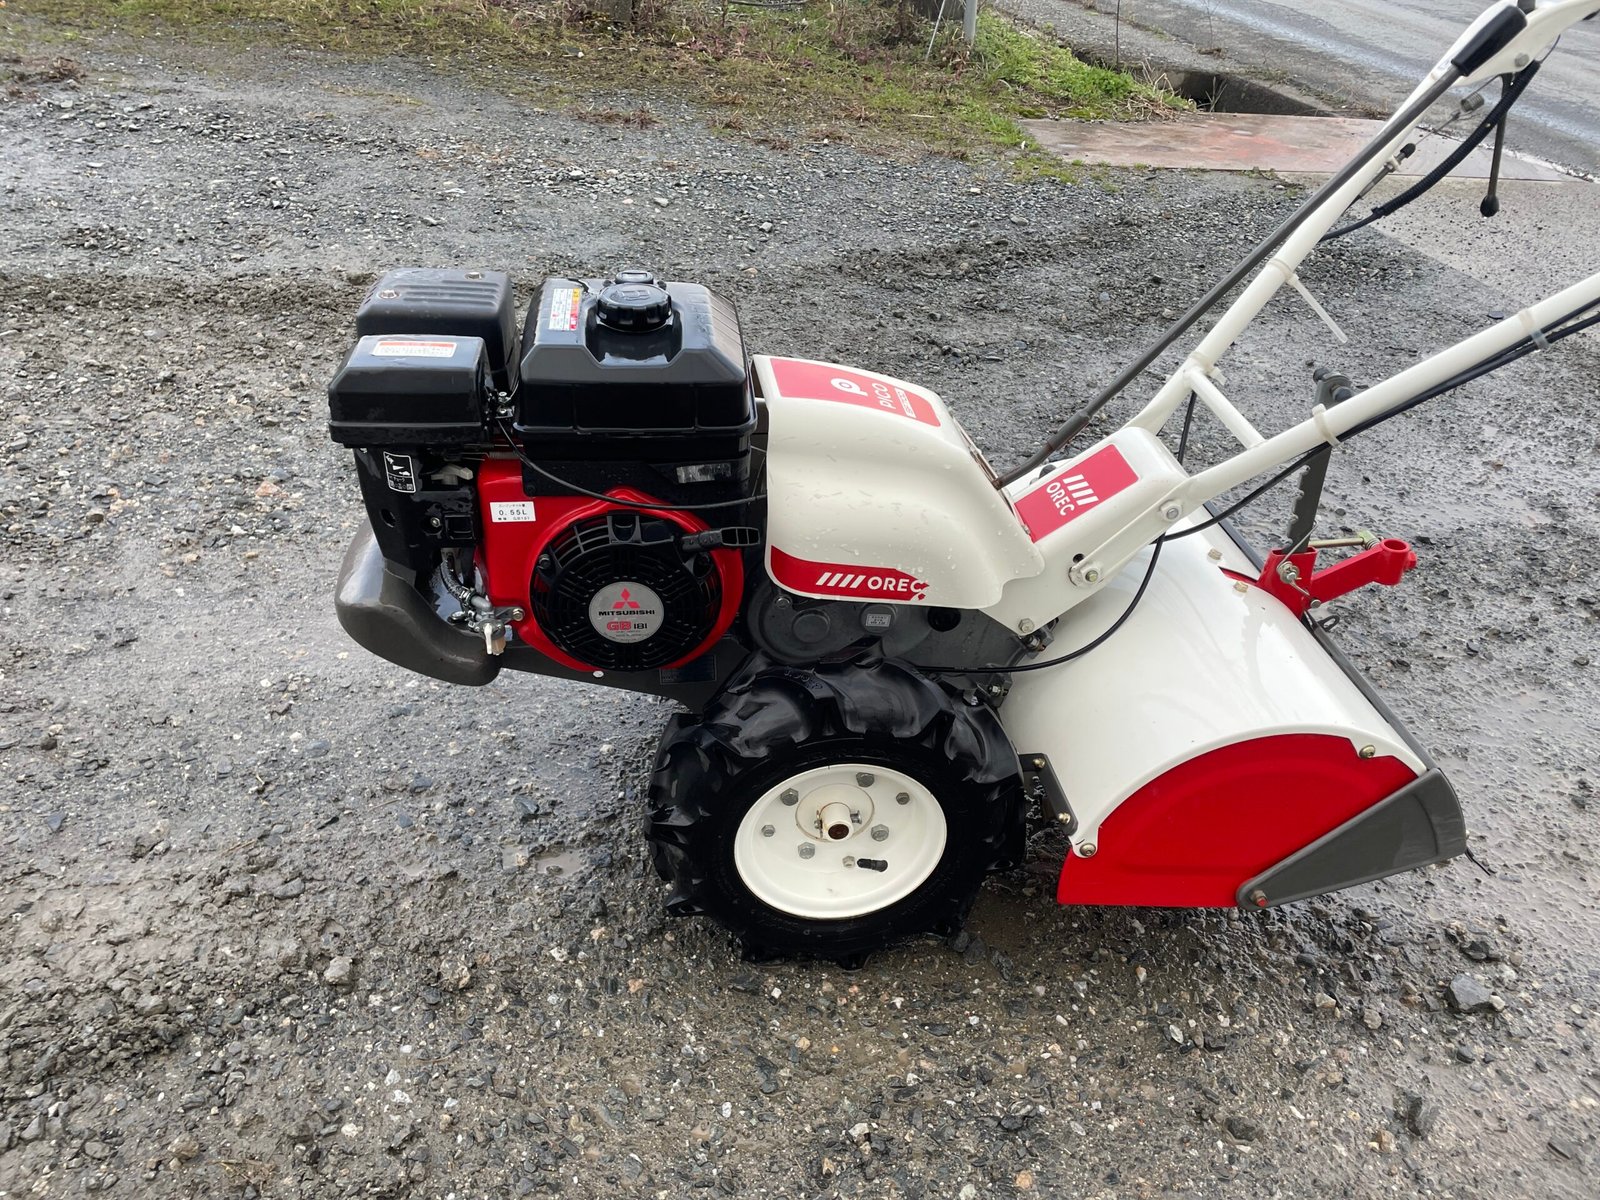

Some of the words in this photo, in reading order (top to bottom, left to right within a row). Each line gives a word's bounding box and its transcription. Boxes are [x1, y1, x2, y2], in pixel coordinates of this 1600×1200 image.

[871, 382, 897, 410] PICO
[1046, 481, 1075, 516] OREC
[867, 576, 922, 593] OREC
